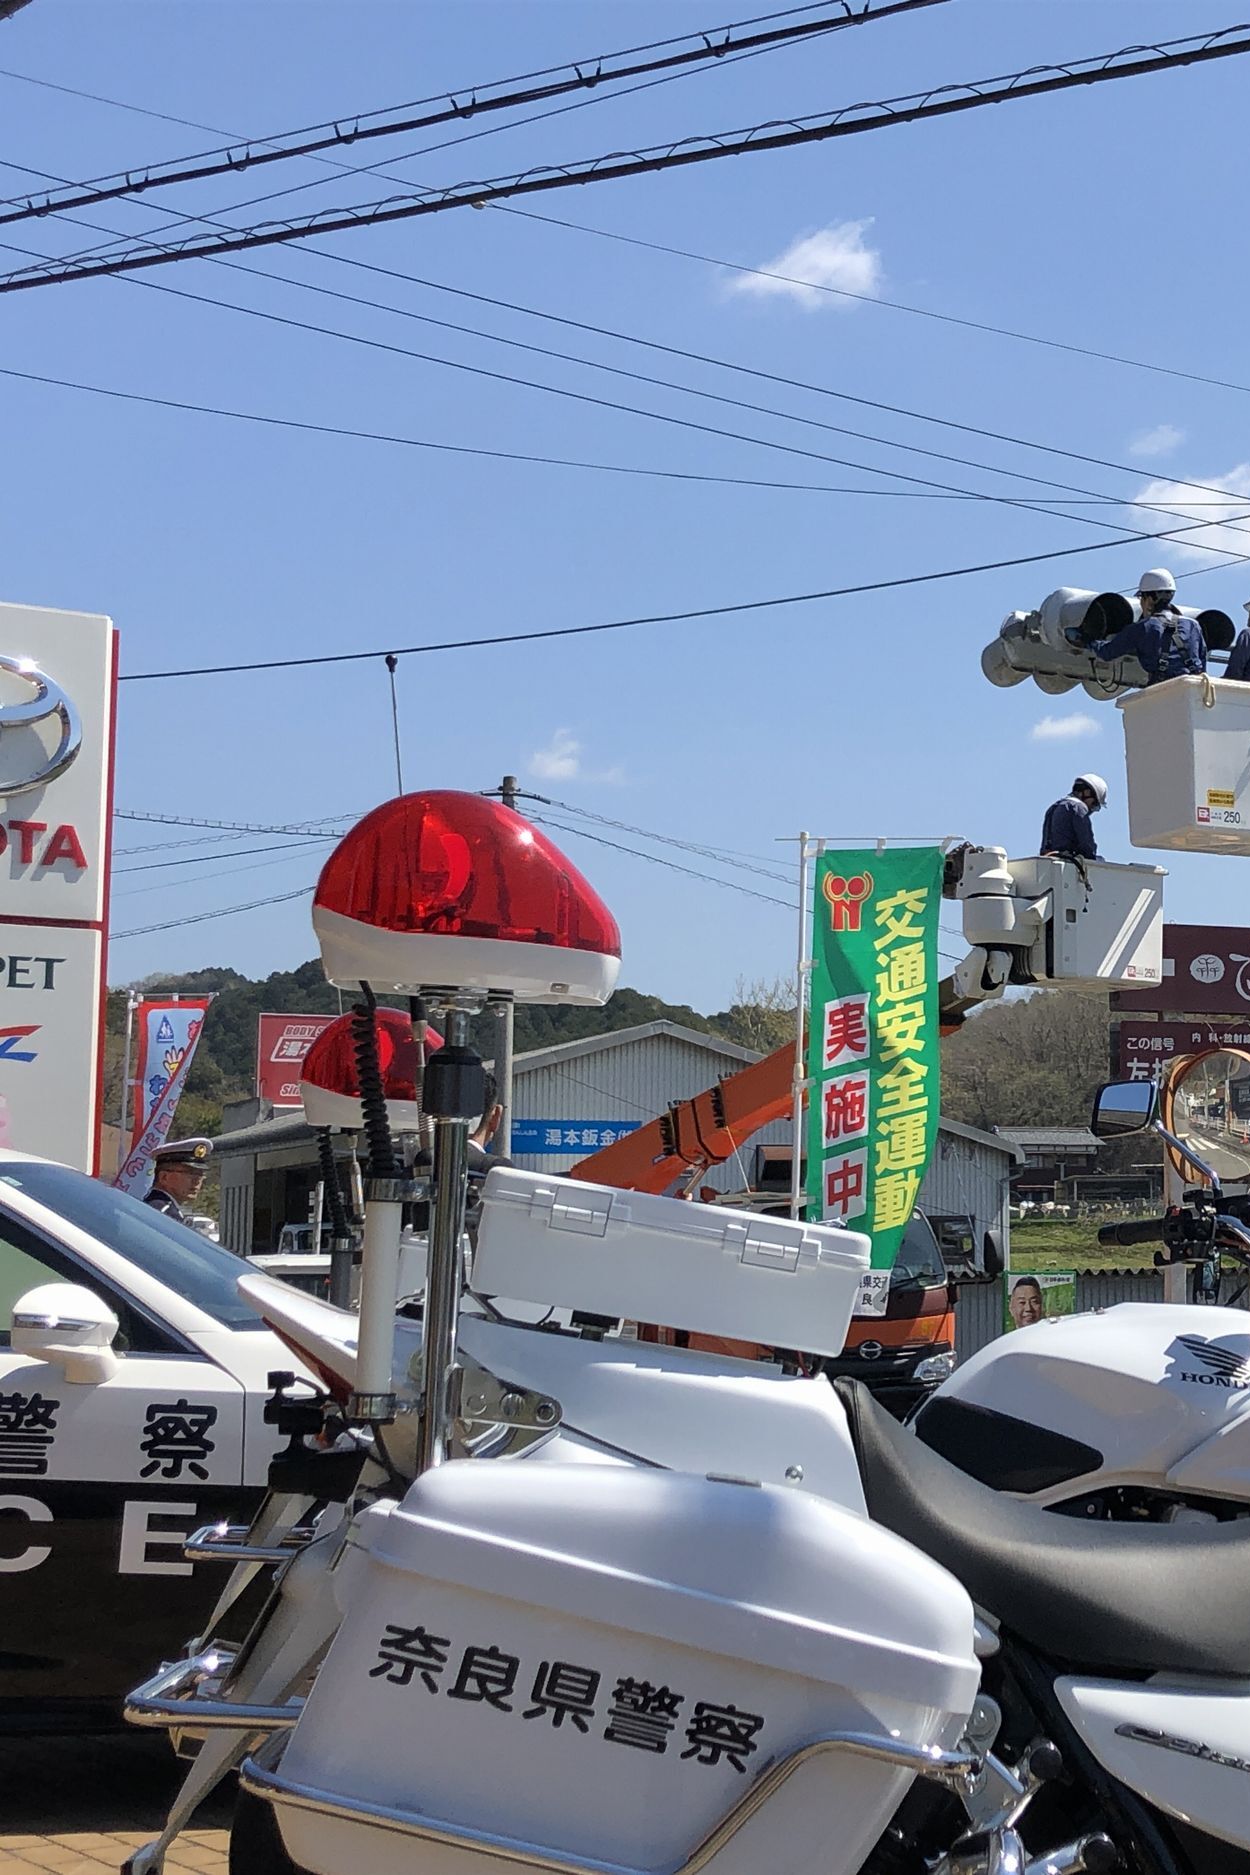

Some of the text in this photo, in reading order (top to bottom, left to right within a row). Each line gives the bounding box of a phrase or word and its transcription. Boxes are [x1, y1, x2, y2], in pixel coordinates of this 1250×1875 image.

[1223, 811, 1241, 824] 250
[0, 820, 88, 869] TA
[0, 955, 67, 990] ET
[872, 886, 929, 1231] 交通安全運動
[1126, 1037, 1175, 1051] この信号
[825, 1001, 869, 1217] 実施中
[368, 1623, 765, 1776] 奈良県警察
